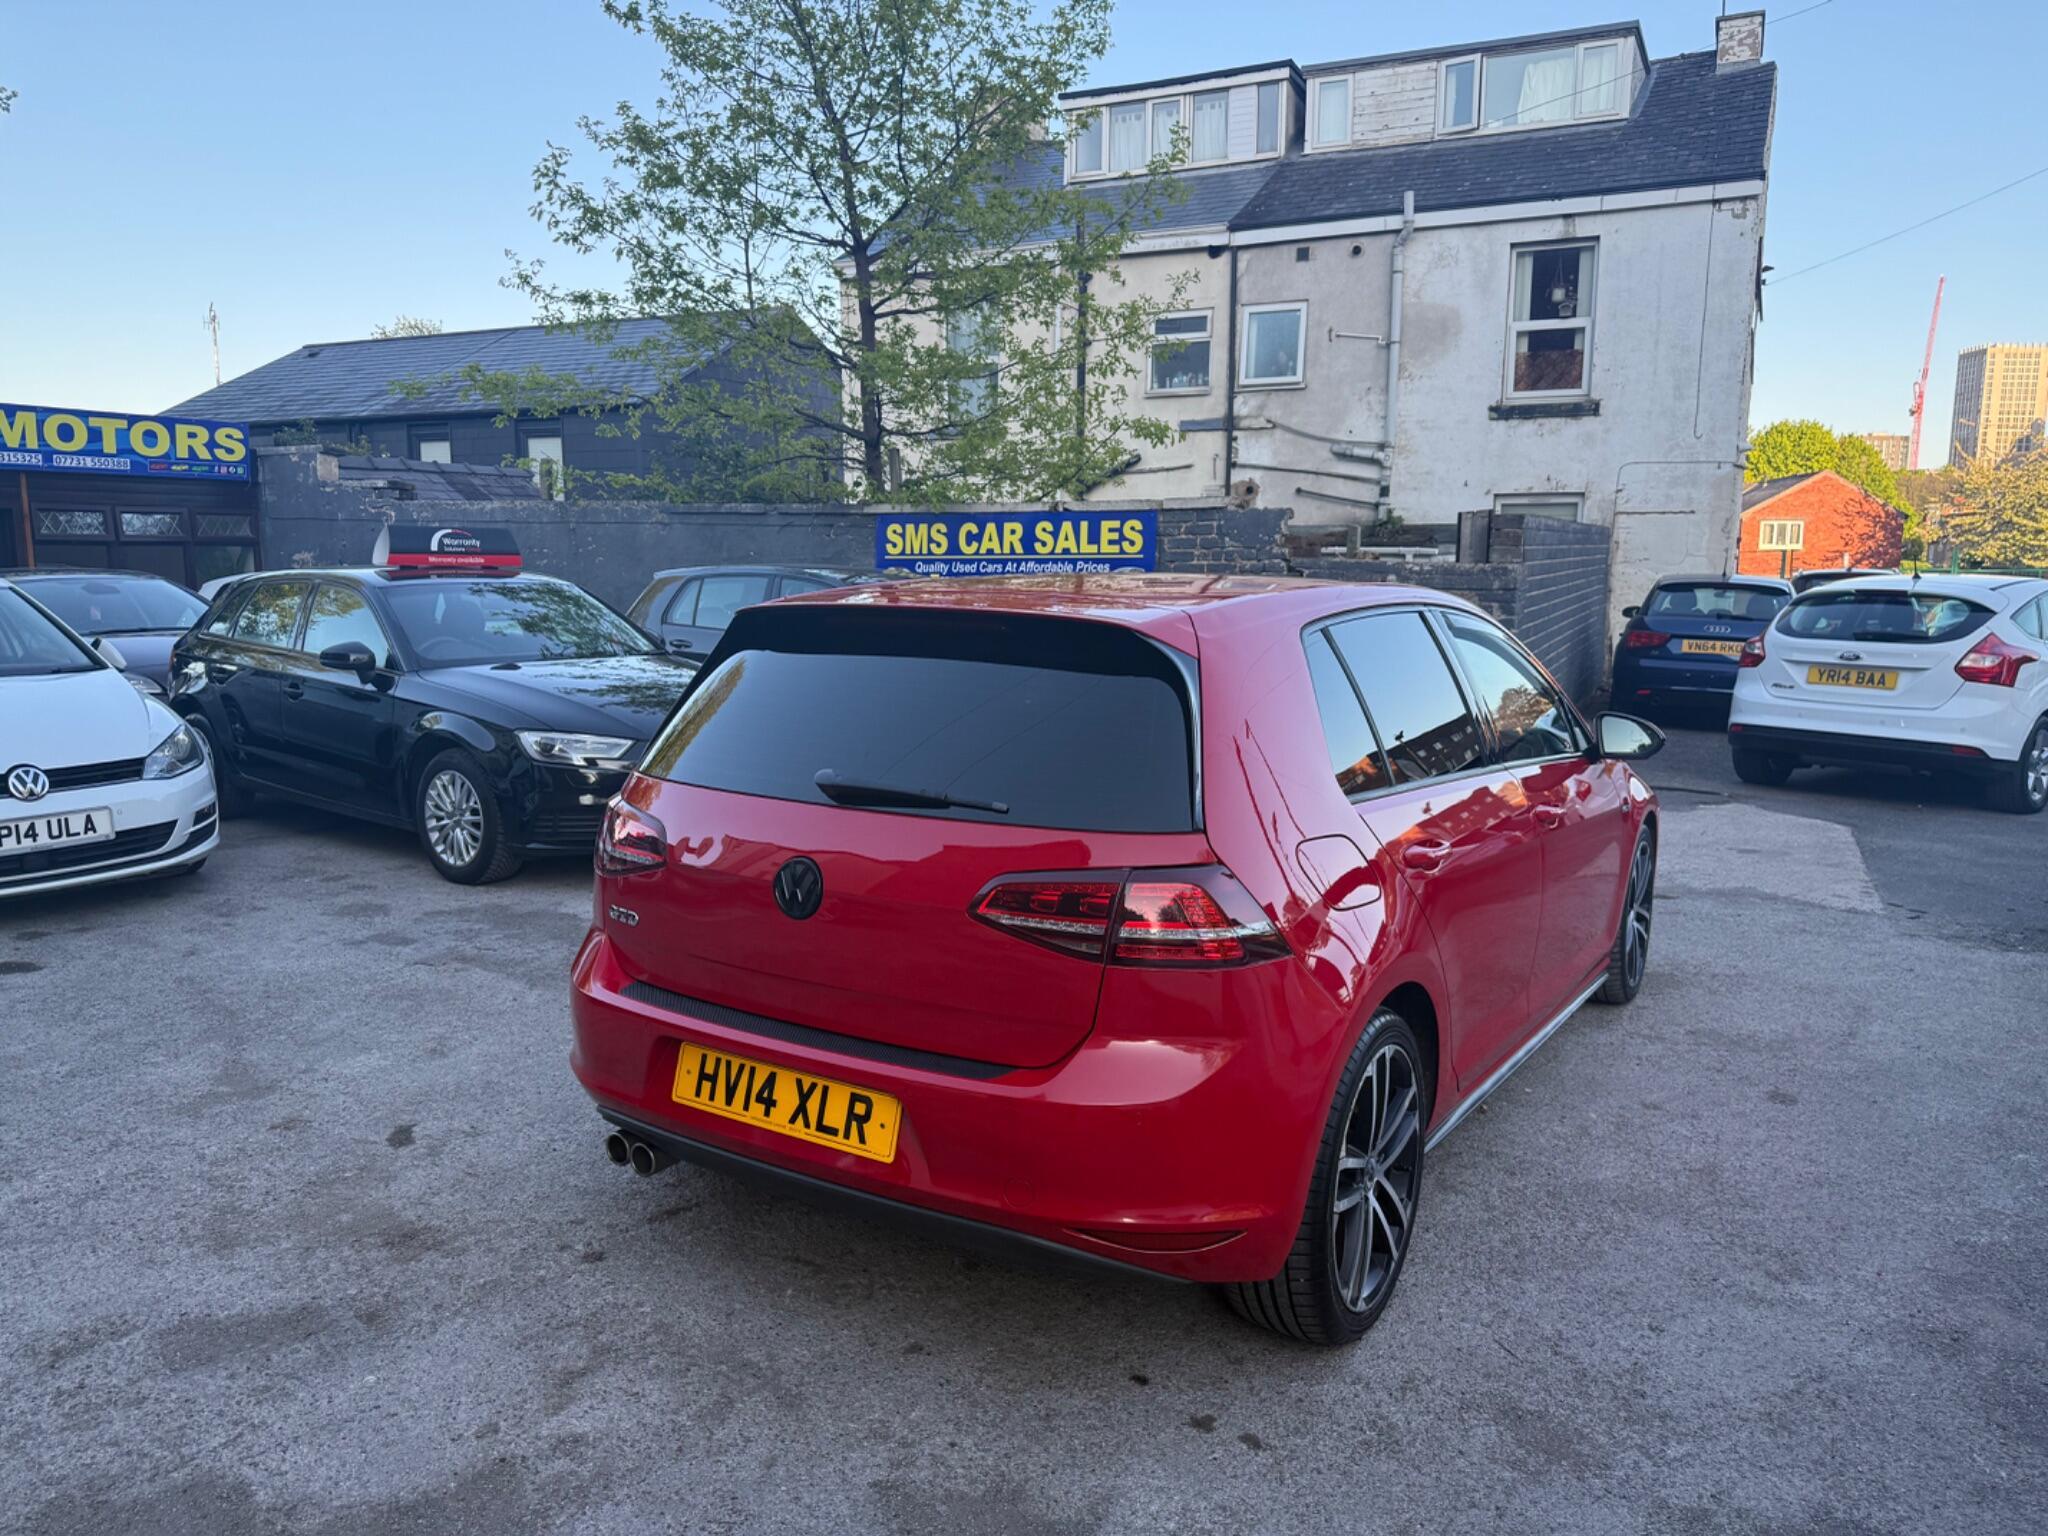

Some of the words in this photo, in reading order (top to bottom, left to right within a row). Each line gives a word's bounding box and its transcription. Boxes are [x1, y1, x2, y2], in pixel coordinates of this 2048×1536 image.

[0, 409, 246, 462] MOTORS
[885, 522, 949, 555] SMS
[958, 521, 1024, 554] CAR
[1033, 519, 1144, 554] SALES
[914, 561, 949, 575] Quality
[951, 561, 977, 573] Used
[979, 561, 1001, 573] Cars
[1005, 561, 1017, 573] At
[1019, 560, 1074, 573] Affordable
[1076, 561, 1110, 573] Prices
[1687, 640, 1717, 652] VN64
[1818, 668, 1851, 684] YR14
[1855, 671, 1886, 687] BAA
[46, 813, 97, 840] ULA
[695, 1053, 778, 1119] HV14
[788, 1077, 874, 1145] XLR
